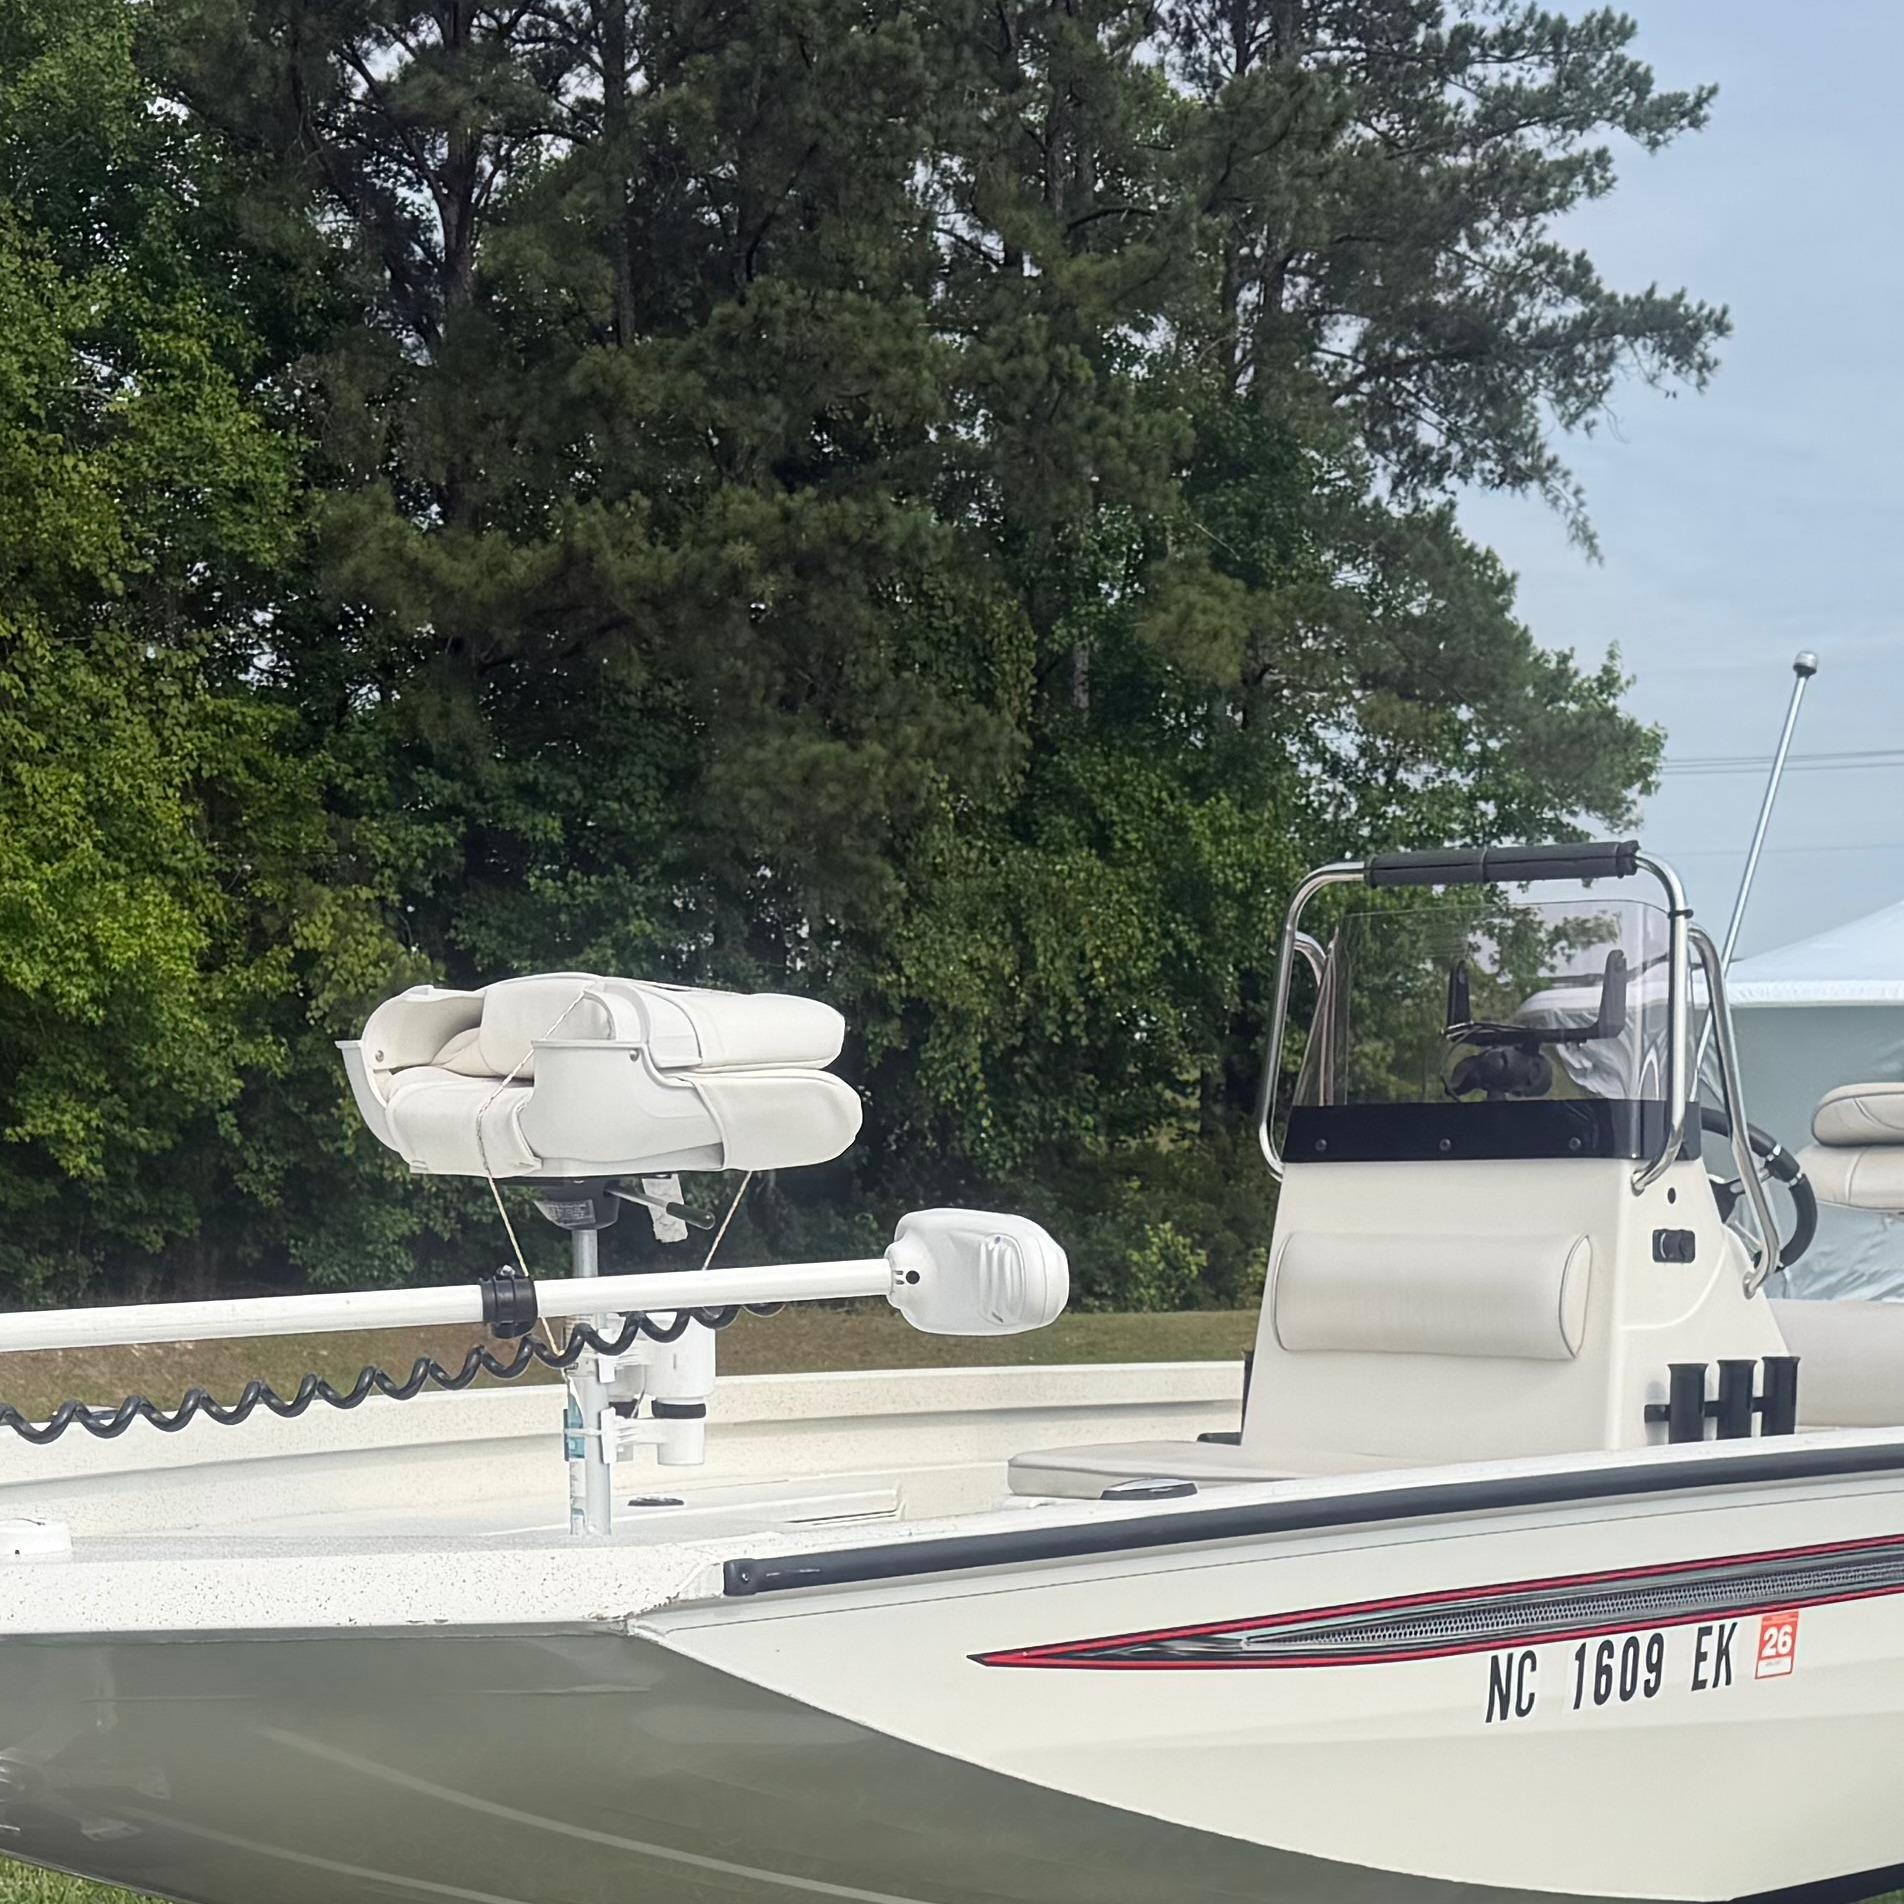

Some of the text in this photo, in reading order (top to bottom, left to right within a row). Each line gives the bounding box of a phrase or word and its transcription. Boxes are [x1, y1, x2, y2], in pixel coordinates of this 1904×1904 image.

[1485, 1621, 1739, 1724] NC 1609 EK
[1761, 1624, 1793, 1658] 26
